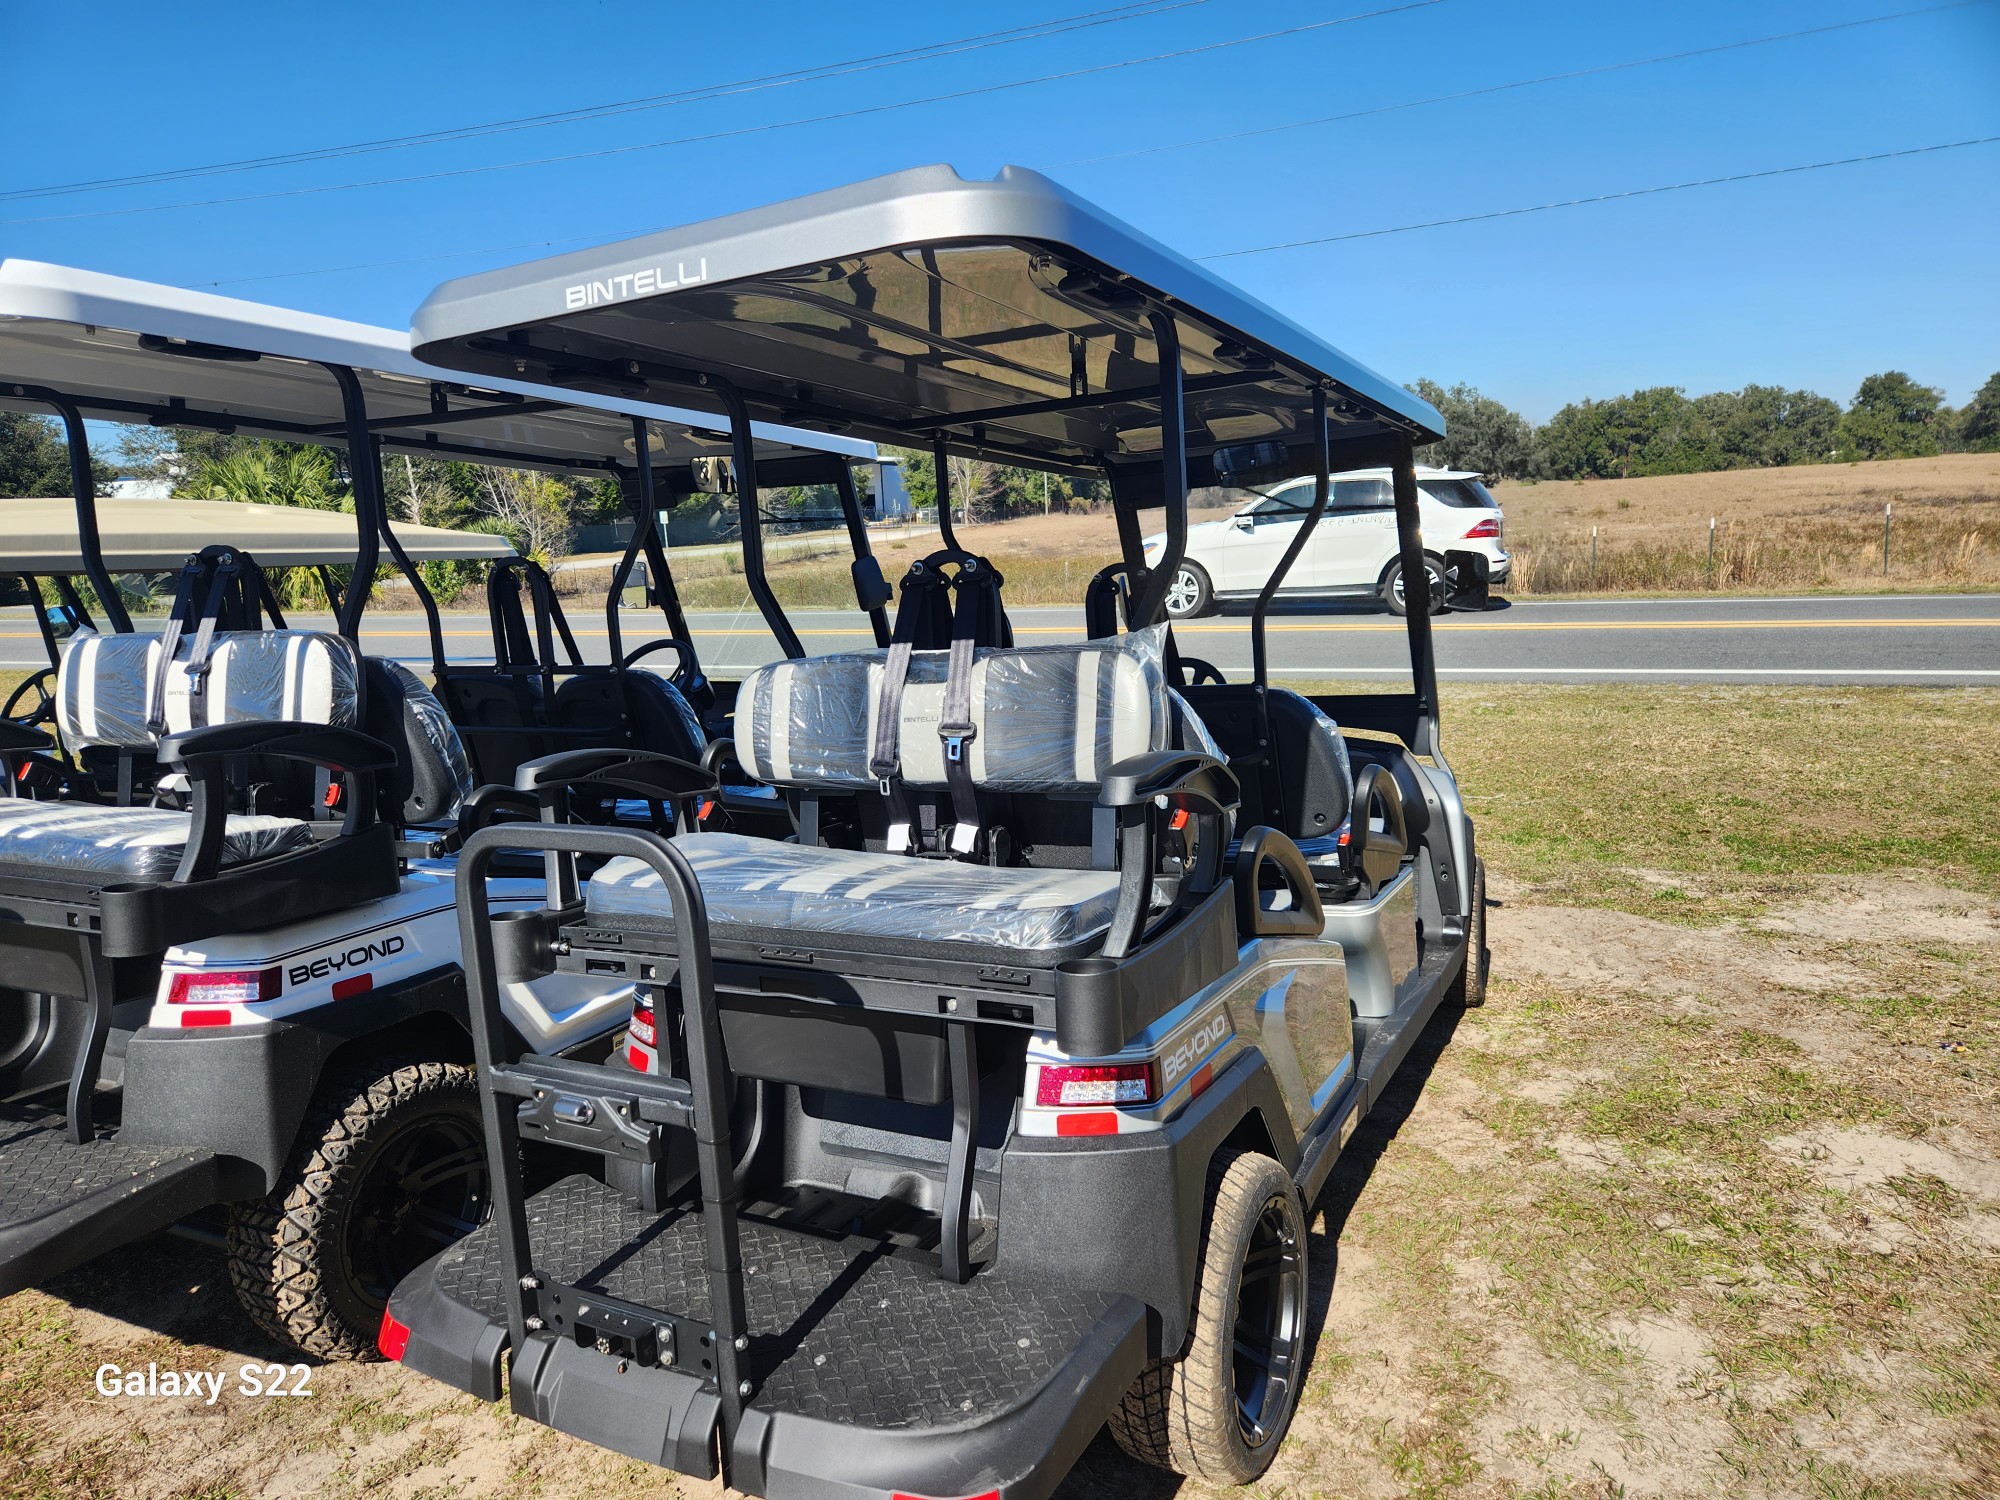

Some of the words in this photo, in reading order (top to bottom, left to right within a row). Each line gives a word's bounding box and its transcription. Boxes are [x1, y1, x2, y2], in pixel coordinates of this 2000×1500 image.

[565, 257, 707, 309] BINTELLI
[288, 936, 405, 986] BEYOND
[1163, 1014, 1225, 1082] BEYOND
